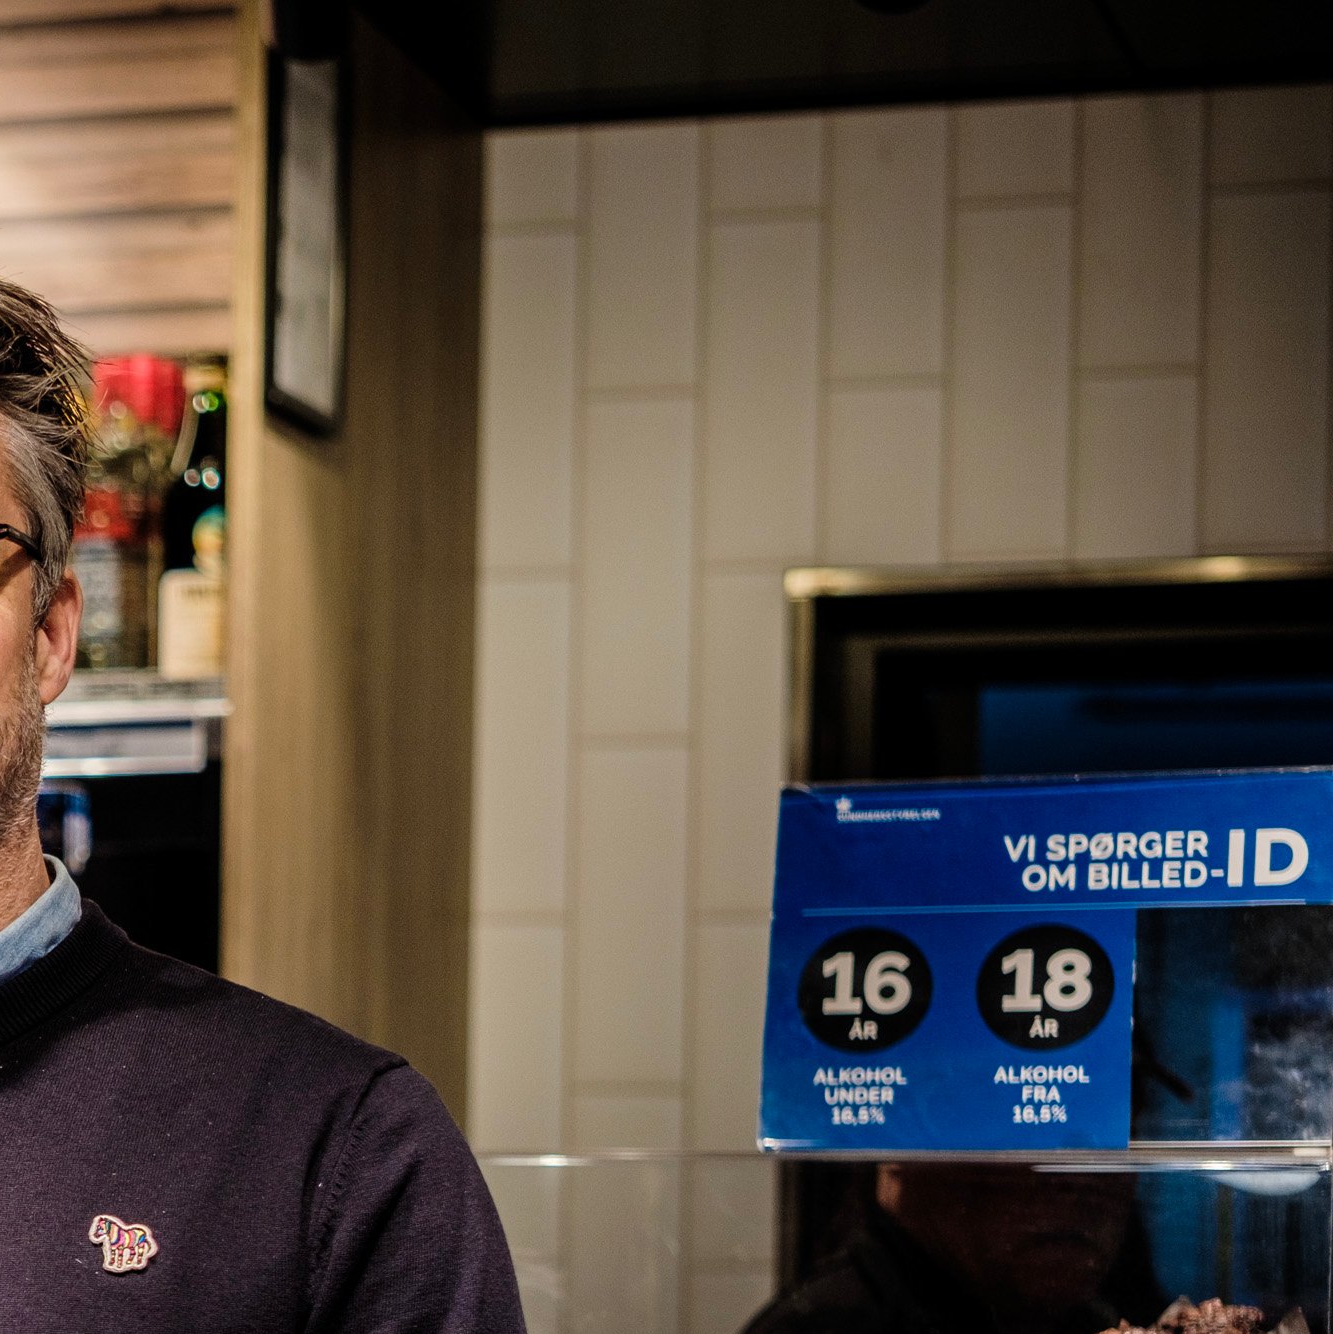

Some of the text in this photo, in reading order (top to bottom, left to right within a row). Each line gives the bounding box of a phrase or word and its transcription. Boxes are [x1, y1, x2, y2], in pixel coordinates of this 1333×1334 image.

[1004, 829, 1210, 864] VI SPØRGER
[1021, 863, 1077, 892] OM
[822, 950, 913, 1016] 16
[1001, 948, 1095, 1013] 18
[849, 1017, 878, 1041] ÅR
[1029, 1015, 1059, 1040] ÅR
[813, 1067, 908, 1087] ALKOHOL
[994, 1065, 1090, 1085] ALKOHOL
[824, 1085, 895, 1105] UNDER
[1021, 1084, 1061, 1104] FRA
